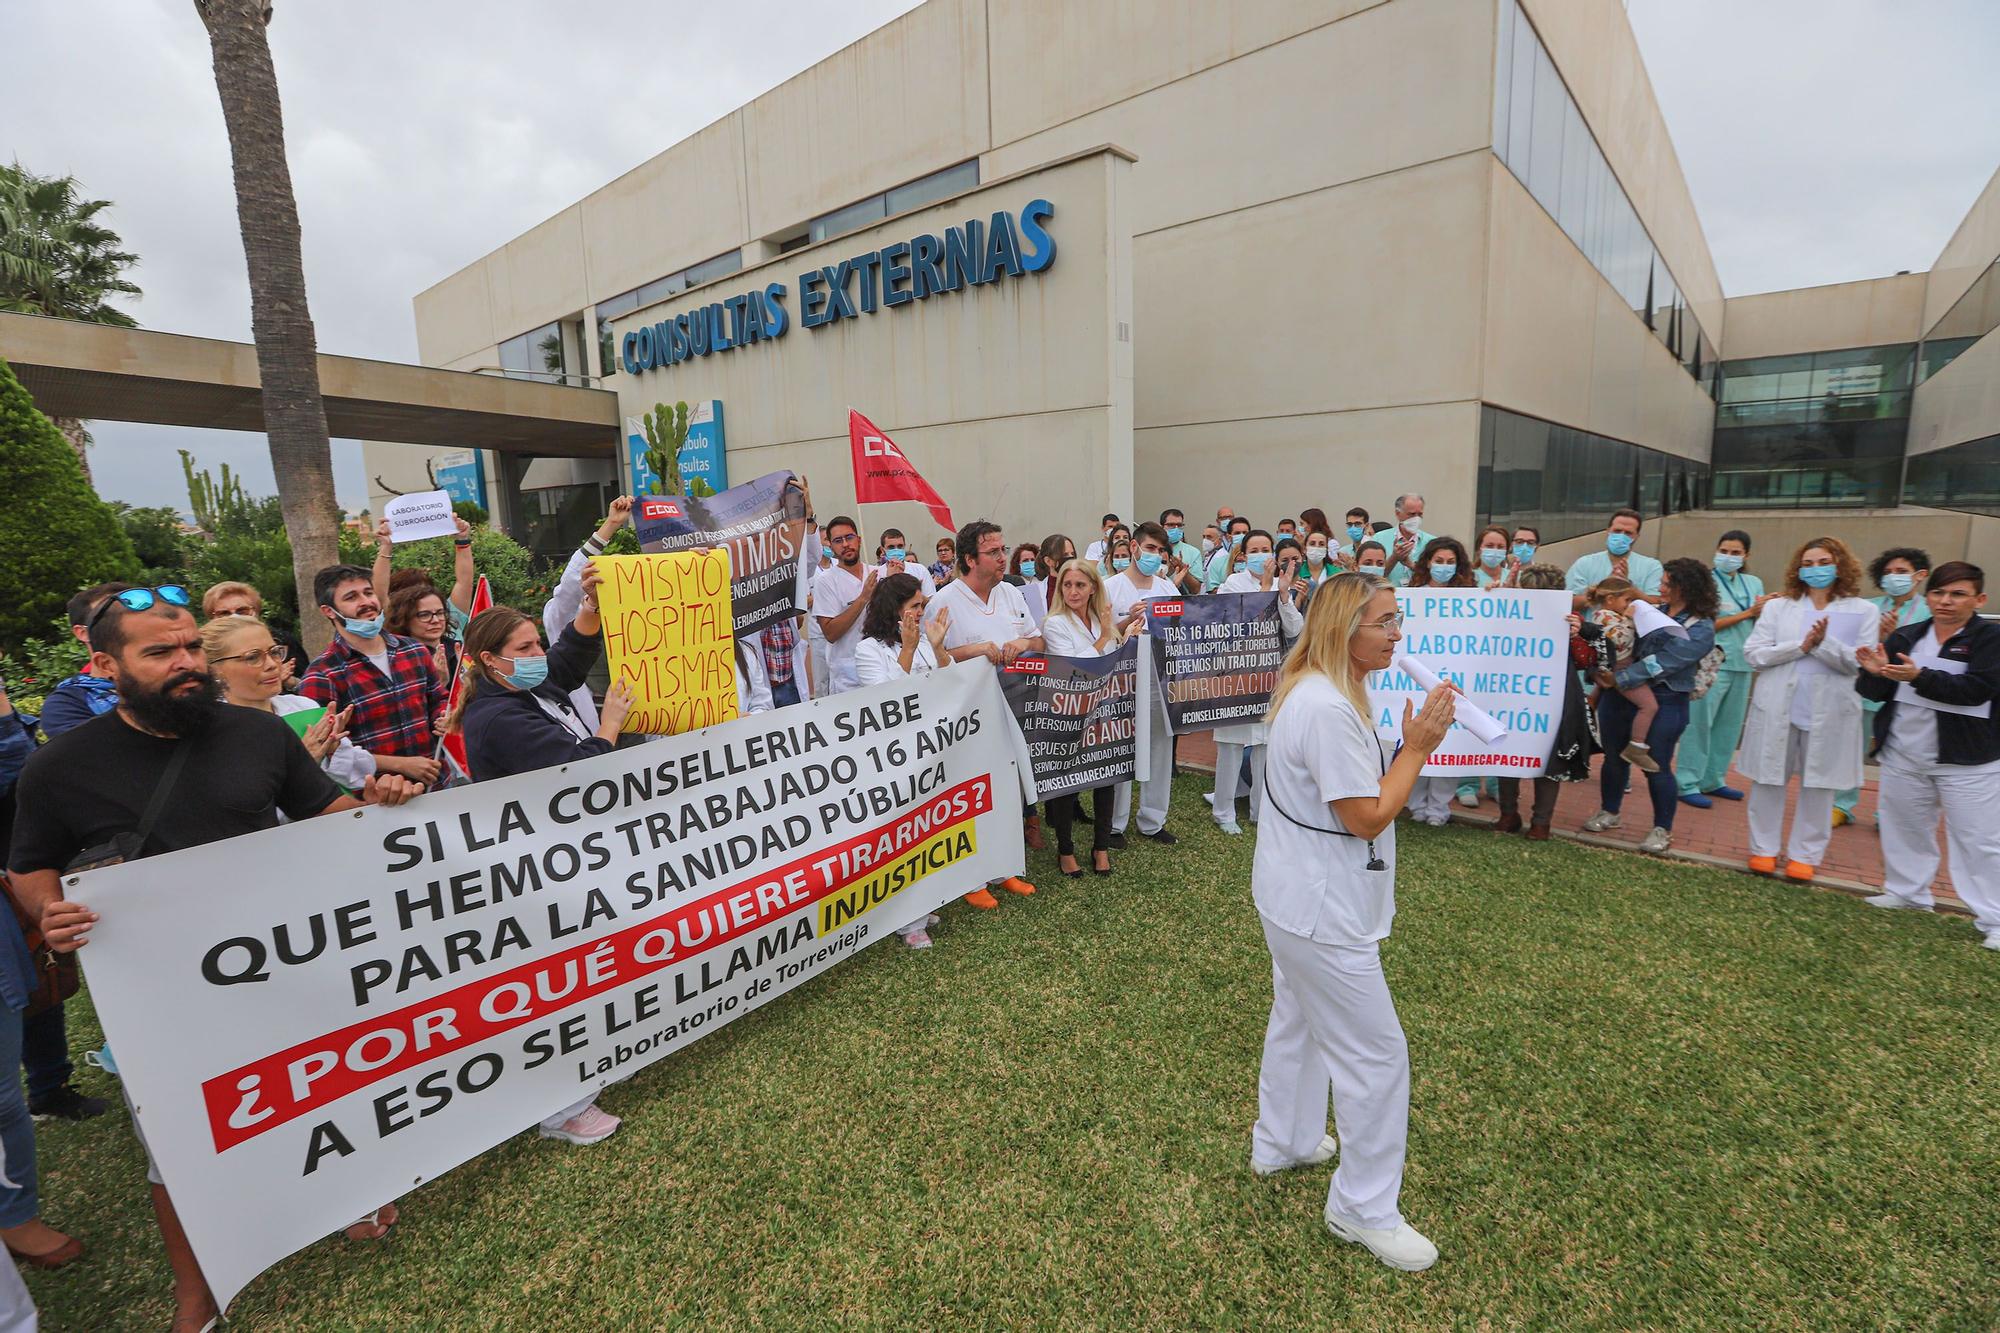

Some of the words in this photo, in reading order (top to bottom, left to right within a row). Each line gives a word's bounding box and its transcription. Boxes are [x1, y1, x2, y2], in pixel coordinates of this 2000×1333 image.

[622, 282, 788, 375] CONSULTAS
[799, 199, 1056, 330] EXTERNAS
[392, 502, 443, 515] LABORATORIO
[646, 505, 680, 516] CCOO
[662, 532, 695, 550] SOMOS
[695, 531, 706, 544] EL
[732, 597, 792, 630] LERIARECAPACITA
[1154, 604, 1181, 614] CCOO
[1425, 598, 1534, 620] PERSONAL
[1163, 626, 1187, 642] TRAS
[1190, 625, 1201, 640] 16
[1204, 622, 1230, 639] AÑOS
[1233, 622, 1245, 637] DE
[1165, 645, 1183, 658] PARA
[1184, 645, 1193, 656] EL
[1194, 641, 1231, 655] HOSPITAL
[1232, 640, 1242, 652] DE
[1407, 635, 1554, 659] LABORATORIO
[1166, 658, 1211, 676] QUEREMOS
[1213, 657, 1226, 671] UN
[1227, 654, 1256, 669] TRATO
[1026, 675, 1037, 686] LA
[1039, 676, 1092, 692] CONSELLERIA
[1474, 673, 1552, 696] MERECE
[1025, 701, 1049, 713] DEJAR
[1051, 692, 1082, 715] SIN
[1024, 718, 1034, 731] AL
[1035, 718, 1082, 732] PERSONAL
[1081, 725, 1095, 748] 16
[1034, 760, 1062, 774] SERVICIO
[1082, 748, 1112, 764] SANIDAD
[1425, 754, 1541, 768] LLERIARECAPACITA
[383, 821, 445, 873] SI
[459, 800, 536, 852] LA
[548, 721, 828, 824] CONSELLERIA
[833, 693, 922, 742] SABE
[201, 899, 377, 985] QUE
[395, 832, 611, 930] HEMOS
[615, 754, 858, 857] TRABAJADO
[866, 740, 907, 773] 16
[917, 709, 980, 758] AÑOS
[350, 916, 532, 1007] PARA
[548, 887, 617, 940] LA
[626, 815, 812, 910] SANIDAD
[819, 761, 946, 834] PÚBLICA
[479, 940, 618, 1022] QUÉ
[633, 869, 810, 964] QUIERE
[813, 781, 986, 889] TIRARNOS?
[302, 1120, 356, 1177] A
[373, 1052, 505, 1138] ESO
[522, 1014, 589, 1070] SE
[604, 983, 660, 1036] LE
[674, 915, 814, 1005] LLAMA
[824, 831, 973, 932] INJUSTICIA
[579, 993, 738, 1082] Laboratorio
[744, 973, 771, 1001] de
[776, 922, 869, 984] Torrevieja
